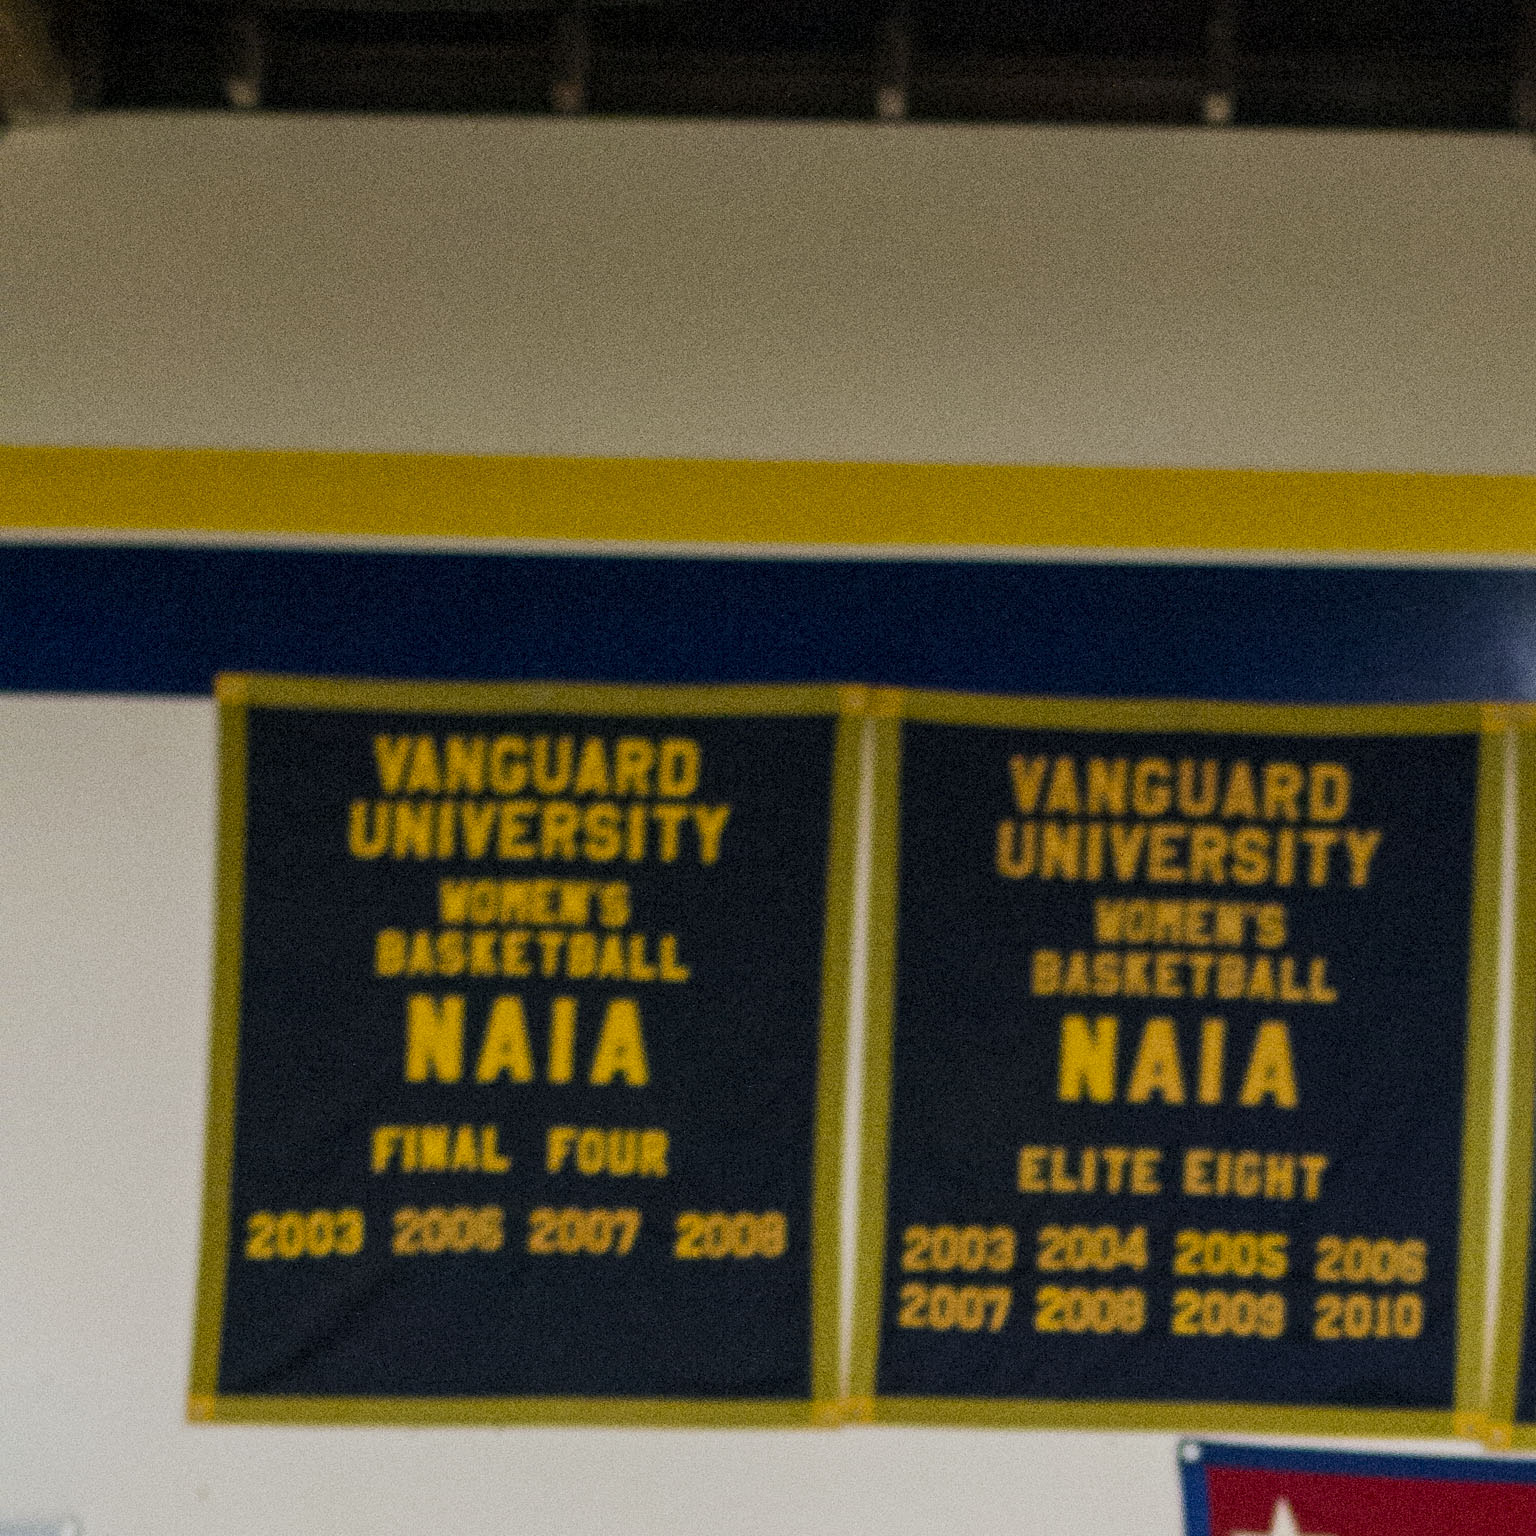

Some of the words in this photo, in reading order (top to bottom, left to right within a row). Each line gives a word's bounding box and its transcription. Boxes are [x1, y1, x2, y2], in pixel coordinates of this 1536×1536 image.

[376, 736, 699, 797] VANGUARD
[1011, 758, 1349, 822] VANGUARD
[349, 798, 728, 862] UNIVERSITY
[998, 822, 1379, 885] UNIVERSITY
[442, 880, 628, 926] WOMEN'S
[1097, 900, 1285, 949] WOMEN'S
[376, 928, 688, 981] BASKETBALL
[1033, 950, 1336, 1003] BASKETBALL
[406, 995, 647, 1085] NAIA
[1059, 1016, 1296, 1107] NAIA
[373, 1127, 508, 1172] FINAL
[548, 1127, 668, 1175] FOUR
[1018, 1146, 1160, 1194] ELITE
[1182, 1149, 1327, 1199] EIGHT
[246, 1207, 364, 1259] 2003
[528, 1208, 640, 1253] 2007
[902, 1225, 1015, 1271] 2003
[1038, 1226, 1147, 1270] 2004
[1174, 1230, 1287, 1279] 2005
[899, 1284, 1012, 1330] 2007
[1315, 1293, 1423, 1339] 2010
